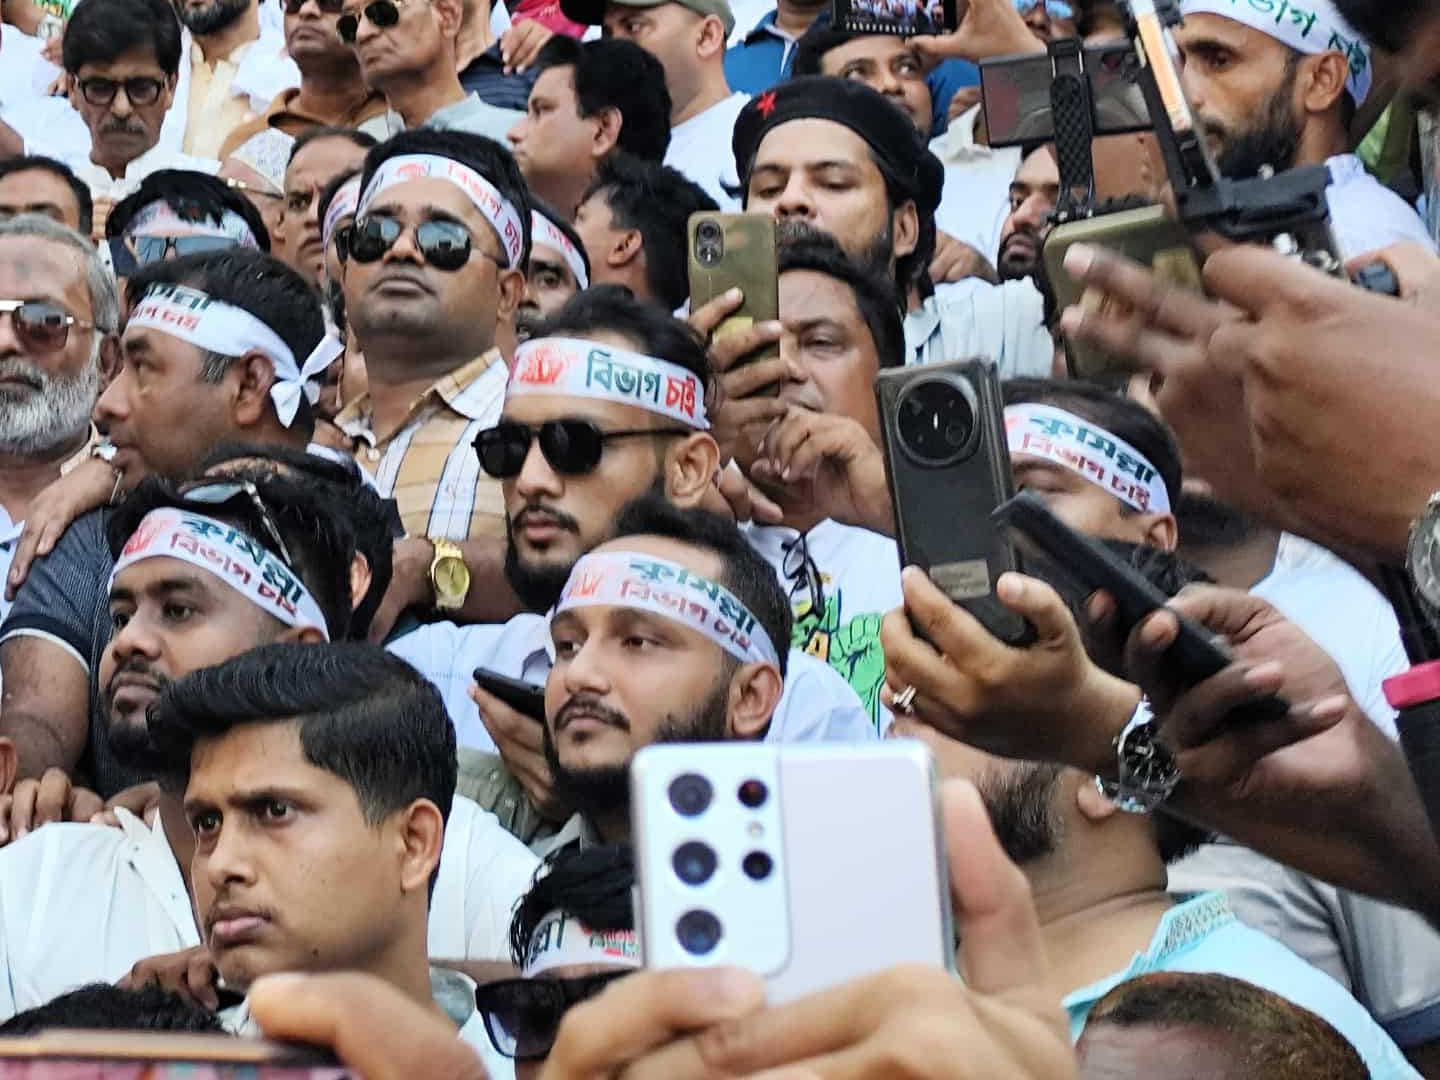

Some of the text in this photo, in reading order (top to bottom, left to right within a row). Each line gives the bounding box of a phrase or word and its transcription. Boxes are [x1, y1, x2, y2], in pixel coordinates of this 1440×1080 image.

[586, 348, 697, 419] বিভাগ চাই
[1023, 433, 1105, 480] বিভাগ
[1029, 417, 1157, 484] কুমিল্লা
[170, 532, 252, 585] বিভাগ
[181, 516, 305, 604] কুমিল্লা
[620, 579, 708, 623] বিভাগ
[629, 558, 757, 634] কুমিল্লা
